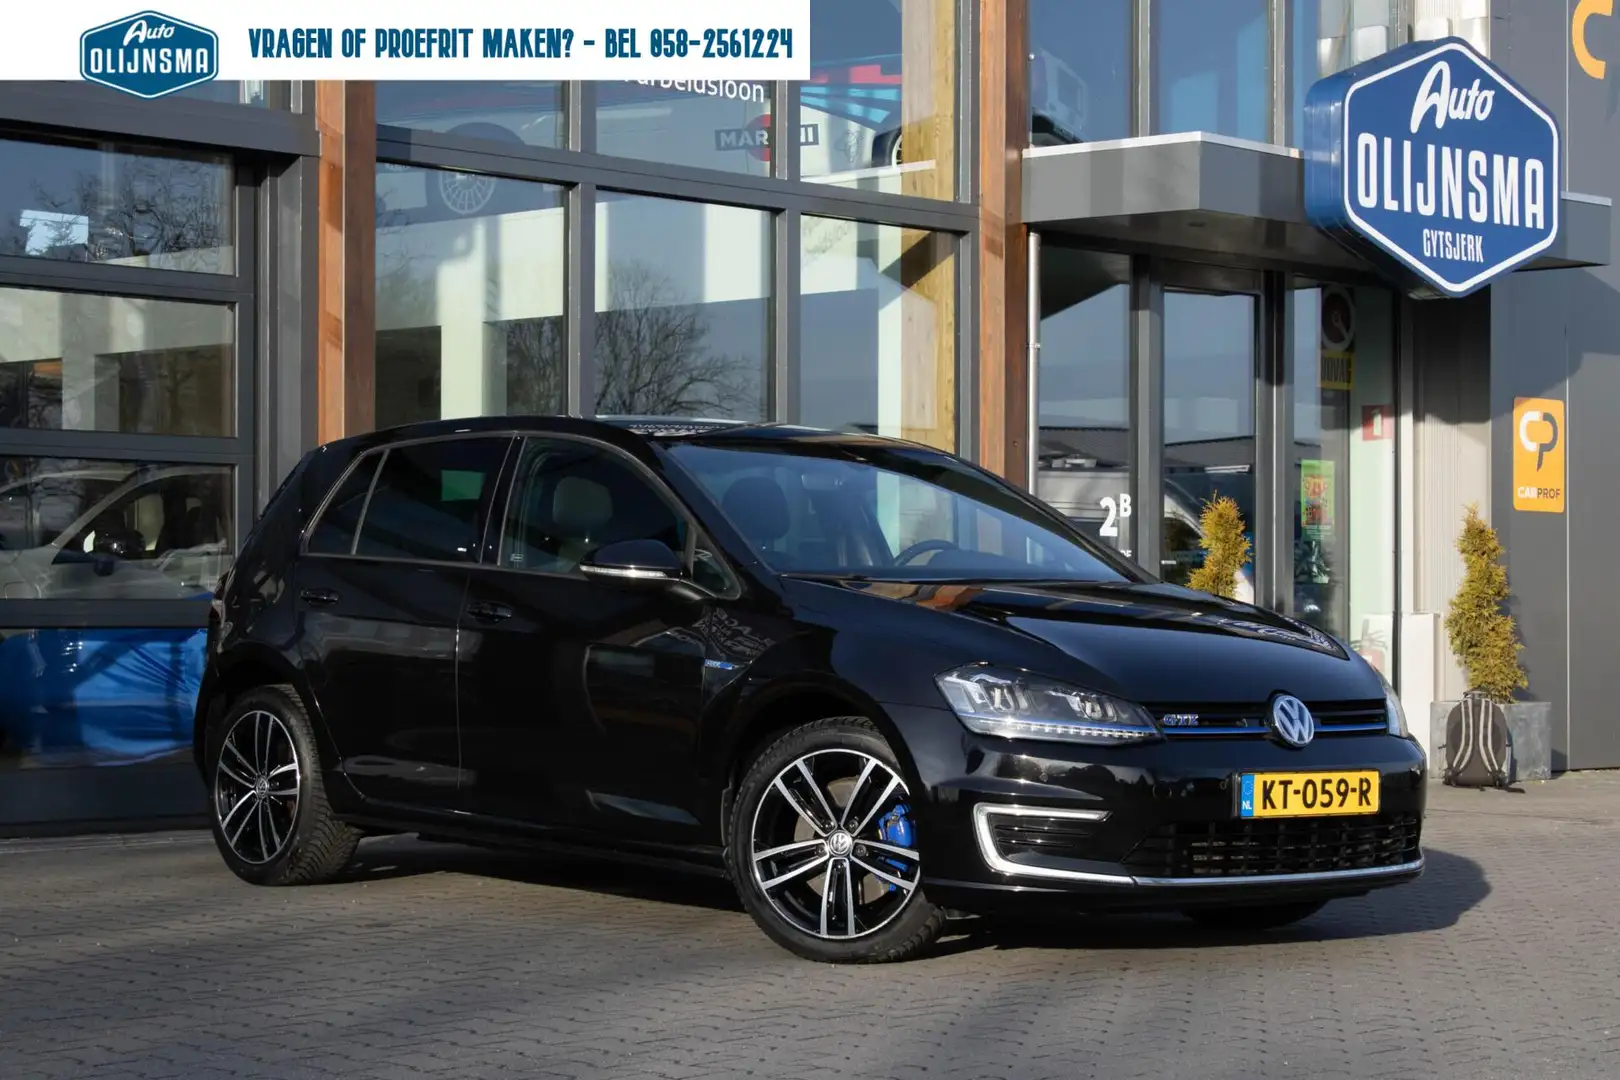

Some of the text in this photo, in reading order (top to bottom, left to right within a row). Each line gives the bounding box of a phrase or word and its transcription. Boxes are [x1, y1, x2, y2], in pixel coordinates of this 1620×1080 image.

[635, 79, 765, 103] eidsloon
[1409, 60, 1496, 134] Auto
[1356, 132, 1545, 230] OLIJNSMA
[1421, 228, 1485, 264] GYTSJERK
[1517, 486, 1561, 500] CARPROF
[1162, 713, 1200, 726] GTE
[1241, 800, 1253, 811] NL
[1260, 776, 1373, 811] KT-059-R
